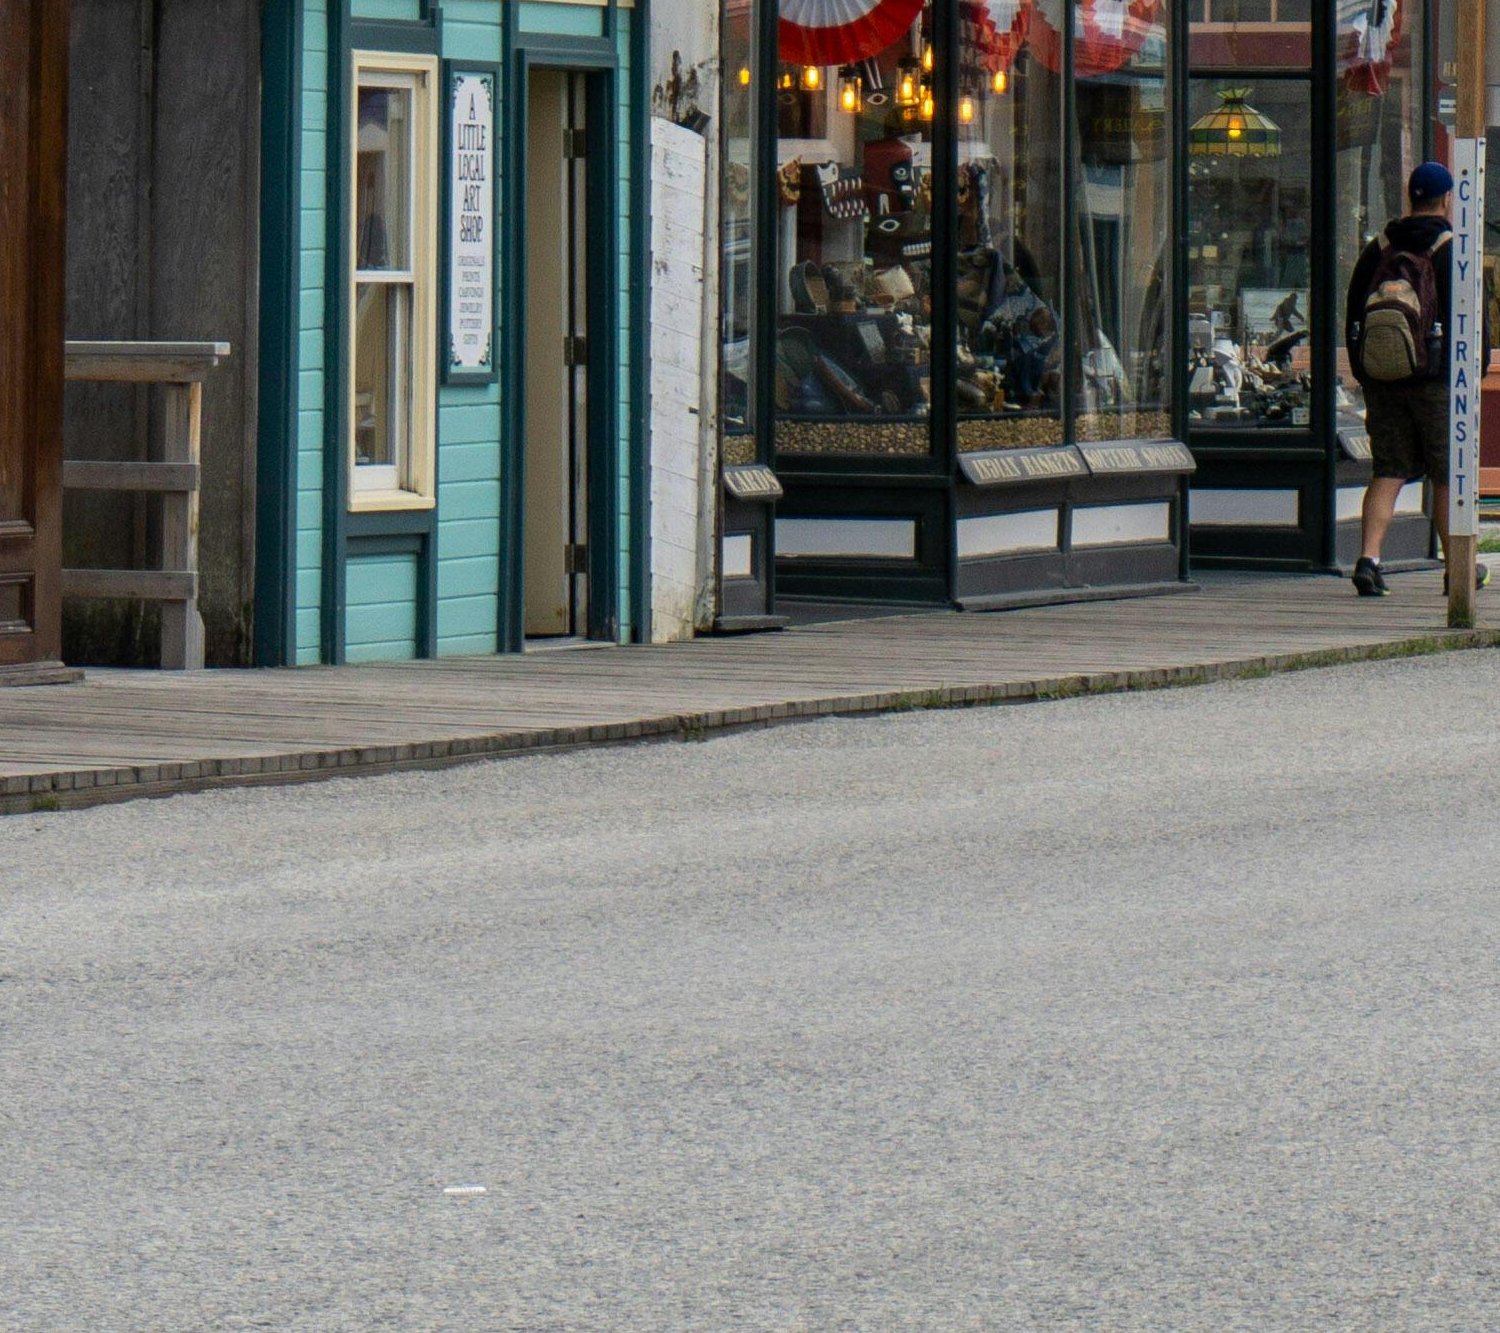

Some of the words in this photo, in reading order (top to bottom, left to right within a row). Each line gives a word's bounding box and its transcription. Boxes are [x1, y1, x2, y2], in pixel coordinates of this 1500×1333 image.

[468, 92, 477, 121] A
[458, 123, 487, 151] LITTLE
[458, 154, 486, 182] LOCAL
[462, 184, 481, 212] ART
[460, 214, 484, 243] SHOP
[1457, 179, 1471, 282] CITY
[1455, 313, 1468, 495] TRANSIT
[972, 456, 1022, 480] INDIAN
[1020, 450, 1081, 476] BASKETS
[1081, 447, 1143, 469] SOUVENIR
[1140, 445, 1190, 467] SPOONS
[724, 468, 780, 493] CARDS
